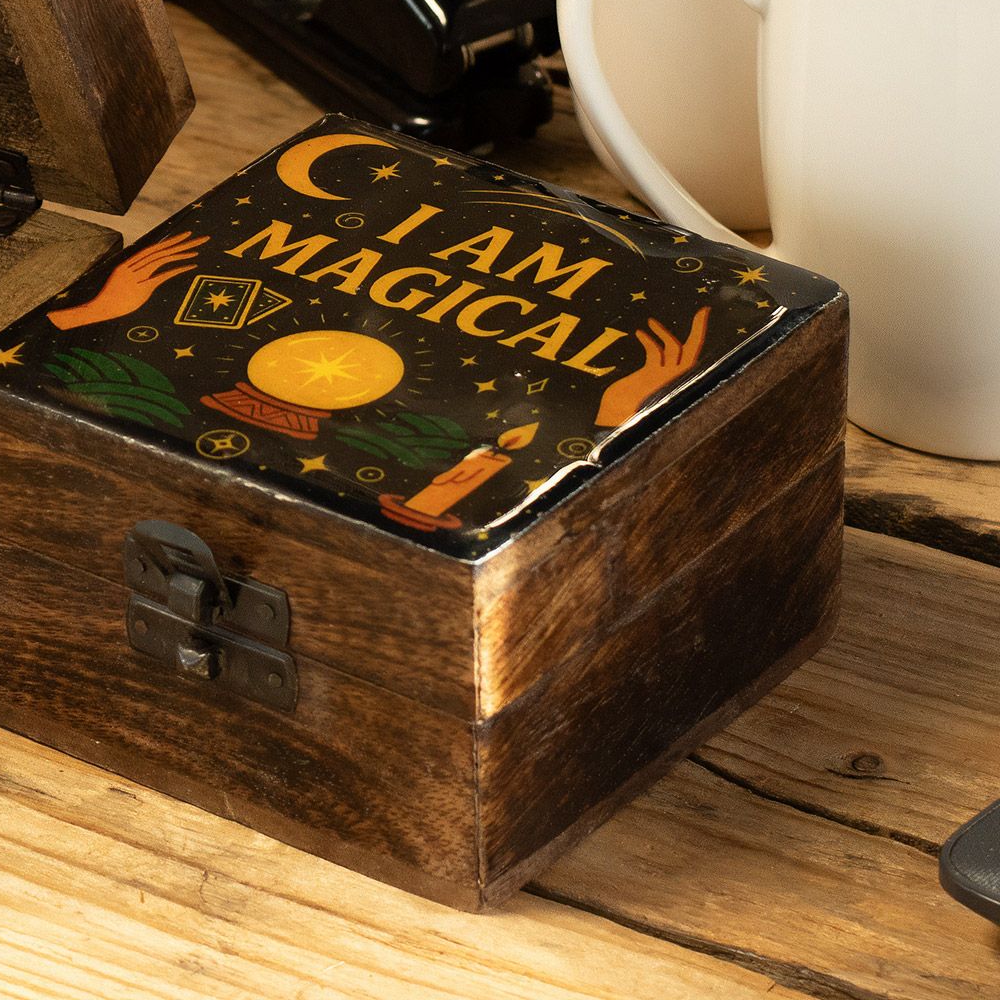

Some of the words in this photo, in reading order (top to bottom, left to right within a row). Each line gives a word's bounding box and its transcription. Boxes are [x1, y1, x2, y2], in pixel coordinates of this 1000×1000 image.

[224, 219, 629, 377] MAGICAL
[377, 203, 444, 245] I
[429, 225, 614, 300] AM
